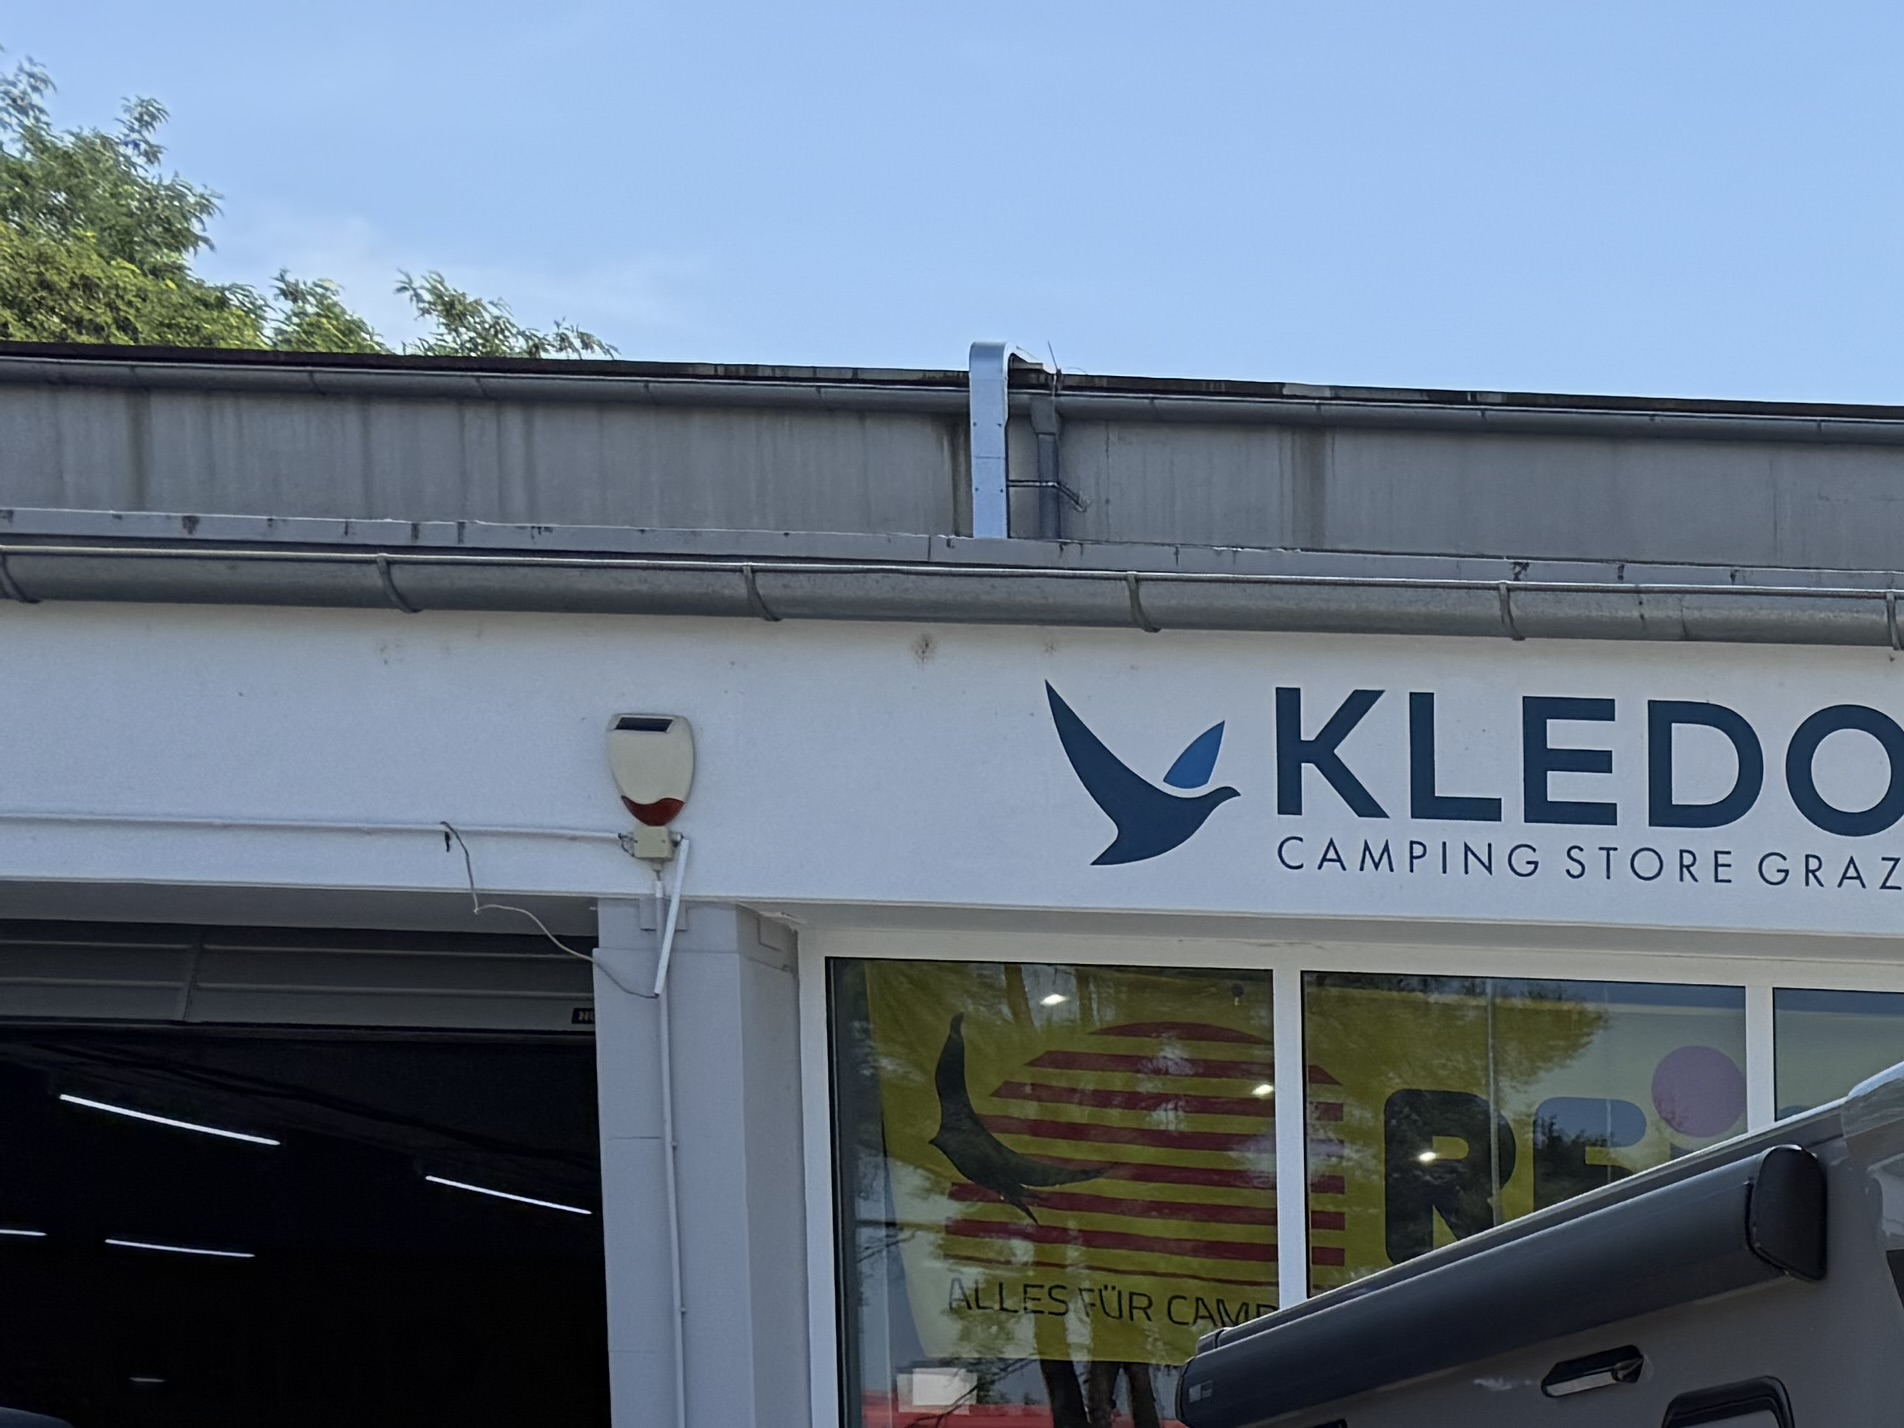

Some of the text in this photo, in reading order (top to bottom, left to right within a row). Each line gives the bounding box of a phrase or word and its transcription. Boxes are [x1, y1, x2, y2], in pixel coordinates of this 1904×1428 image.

[1277, 836, 1903, 891] CAMPING STORE GRAZ
[948, 1277, 1069, 1317] ALLES
[1078, 1283, 1153, 1323] FÜR
